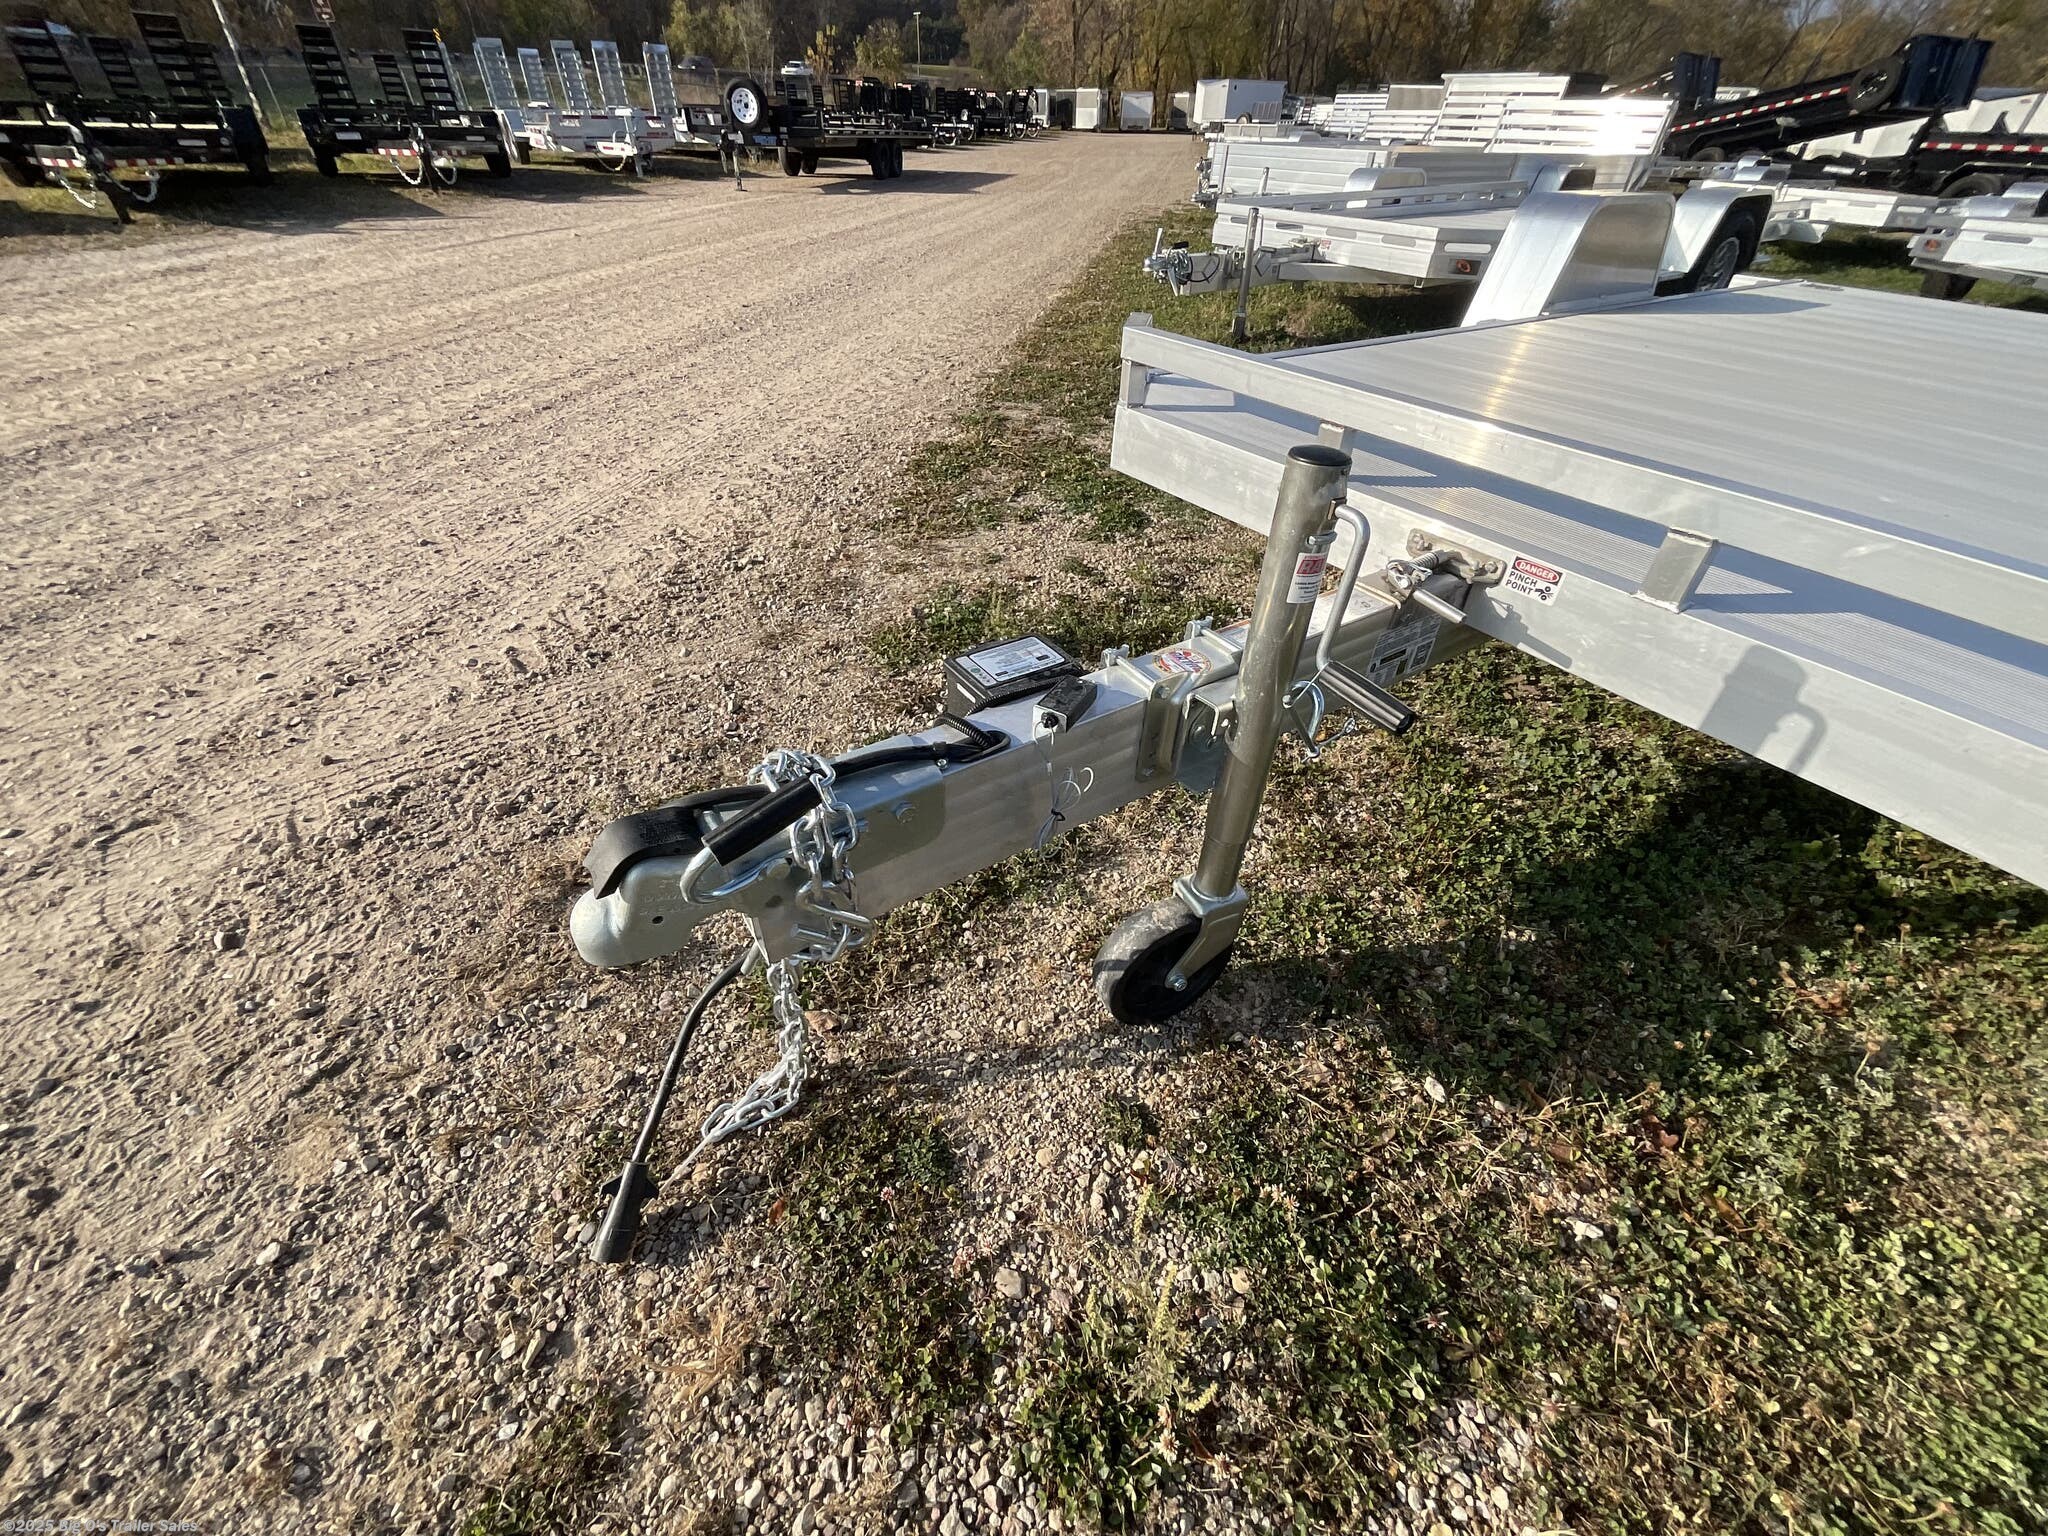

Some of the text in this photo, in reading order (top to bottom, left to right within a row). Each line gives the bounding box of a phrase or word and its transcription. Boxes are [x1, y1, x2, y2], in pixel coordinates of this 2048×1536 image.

[1508, 571, 1538, 587] PINCH
[1519, 562, 1554, 581] DANGER
[1505, 579, 1533, 595] POINT
